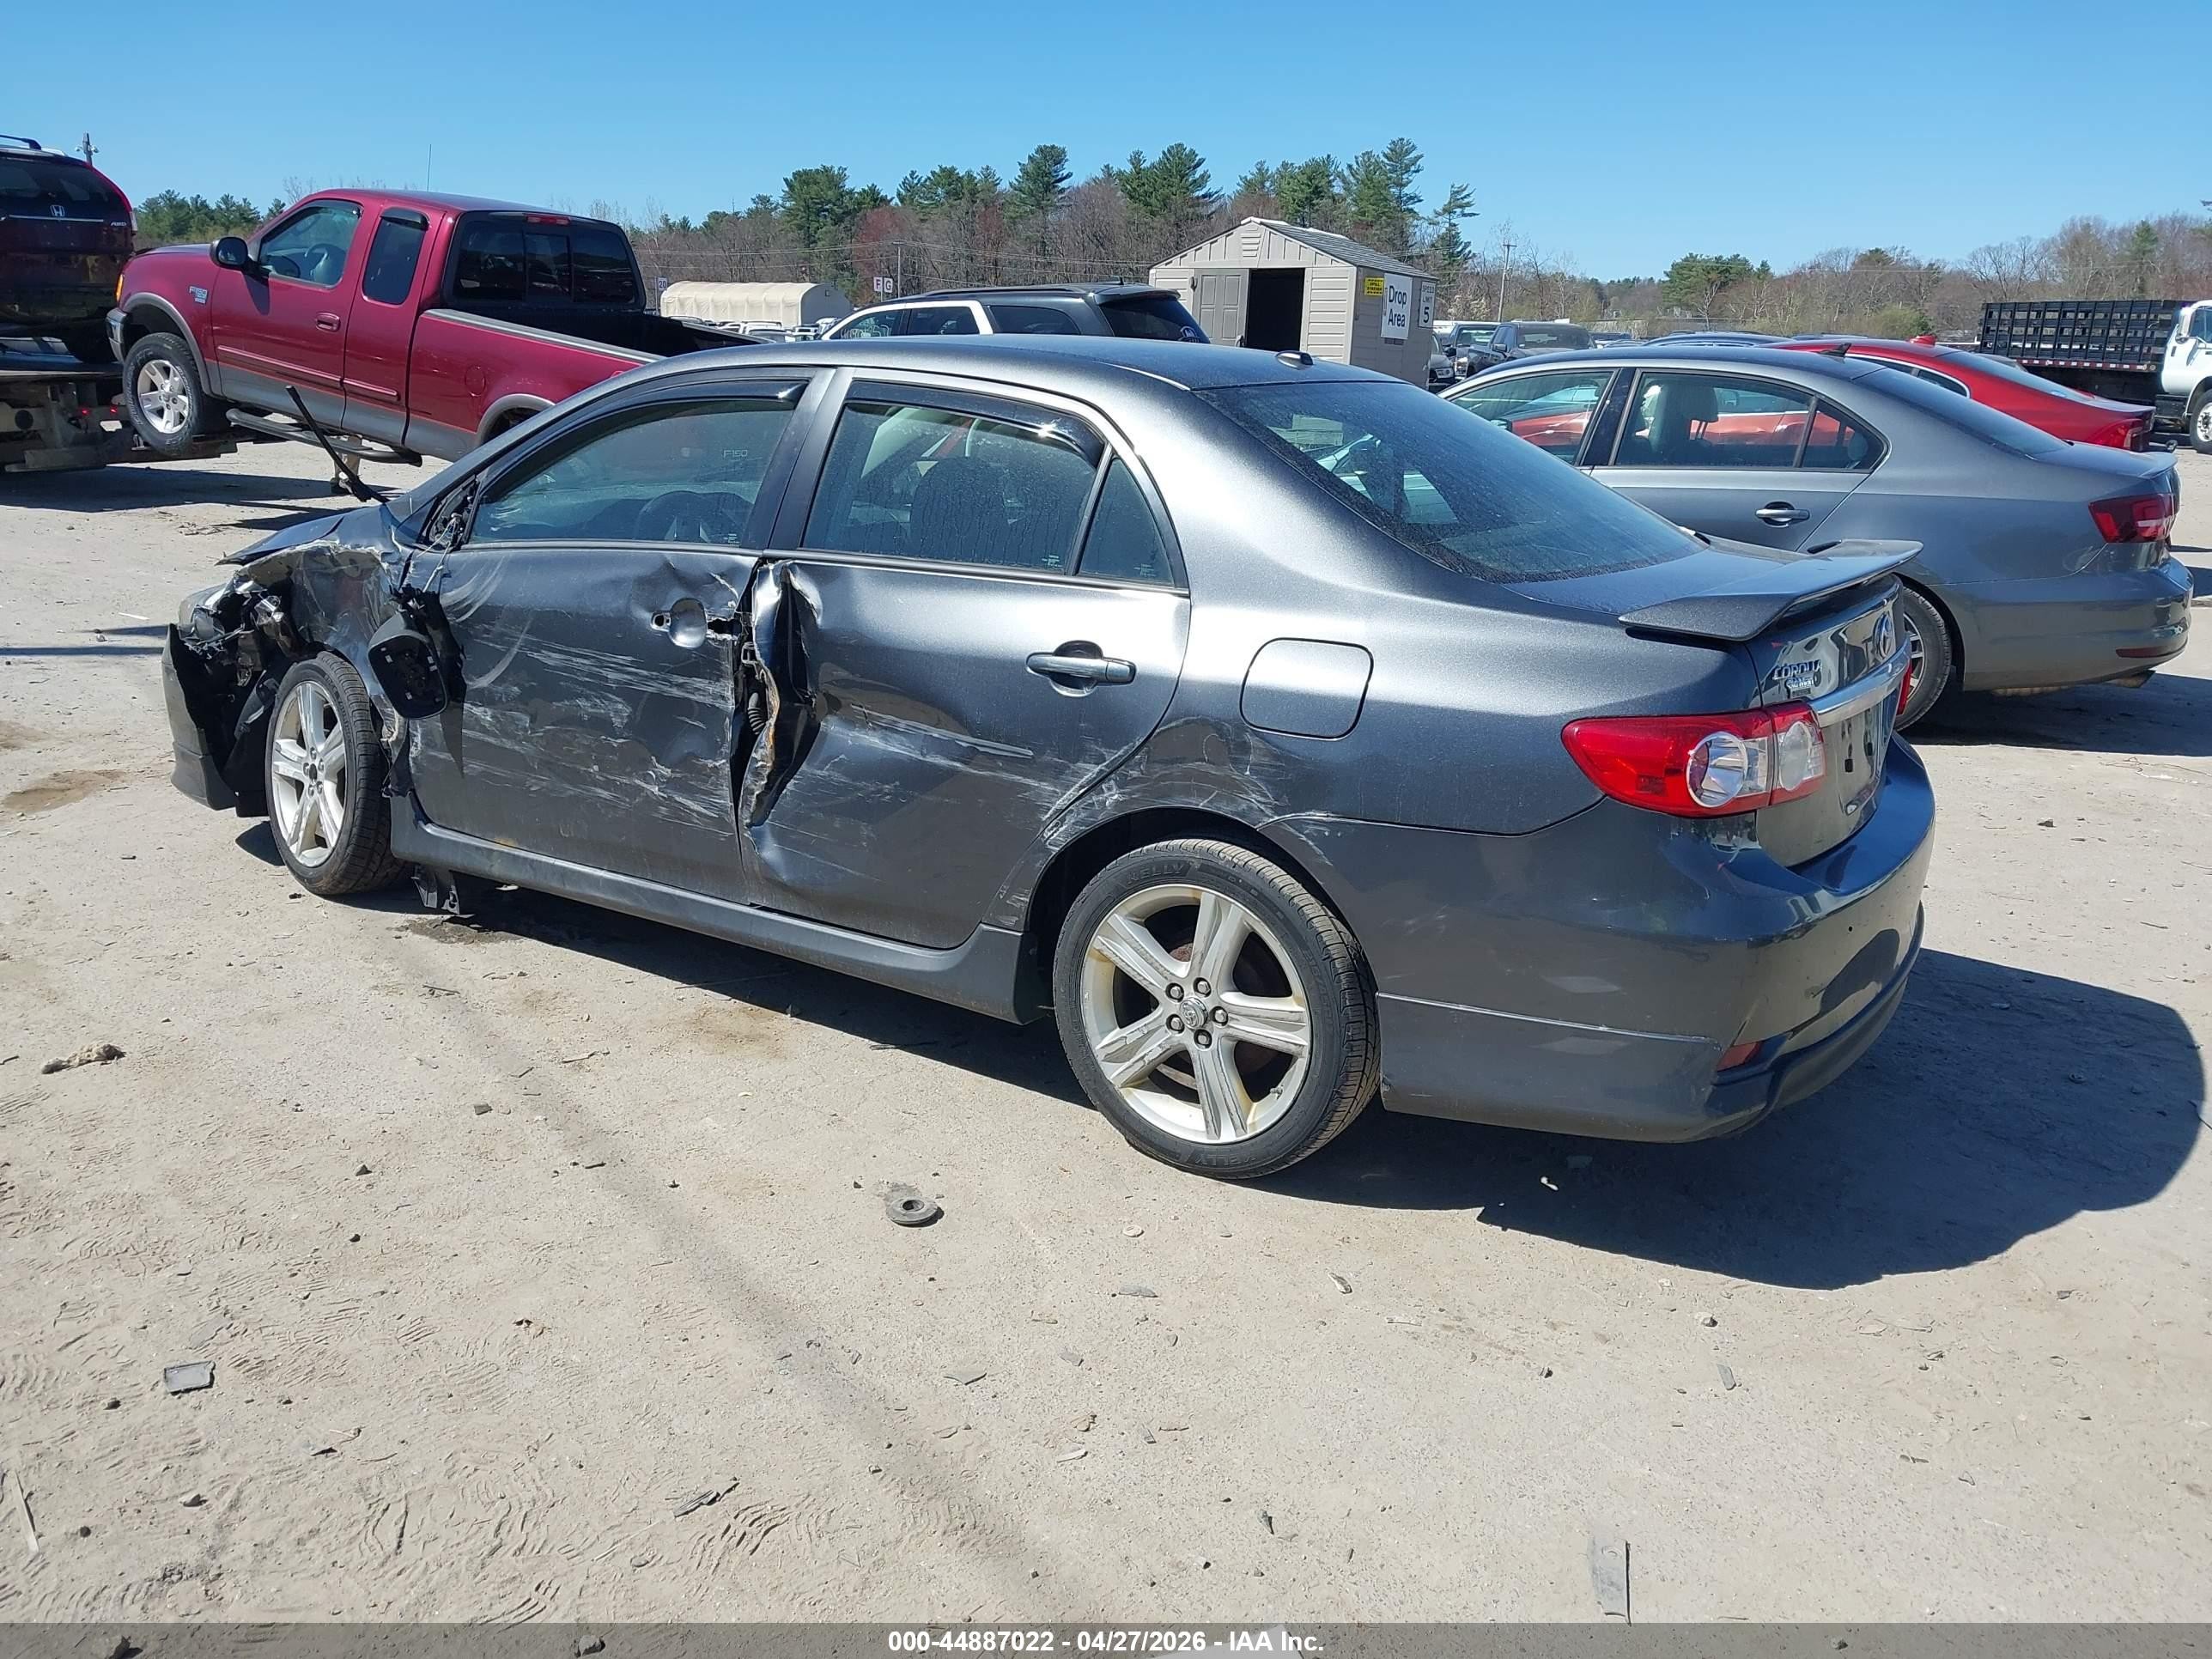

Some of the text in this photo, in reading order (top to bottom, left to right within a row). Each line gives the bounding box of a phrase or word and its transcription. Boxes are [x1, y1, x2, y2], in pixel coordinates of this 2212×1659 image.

[1389, 285, 1407, 309] Drop
[1422, 285, 1435, 294] SPEED
[1422, 295, 1433, 304] LIMIT
[1388, 308, 1406, 327] Area
[1423, 307, 1430, 324] 5
[723, 449, 748, 459] F150
[1771, 659, 1823, 681] COROLLA
